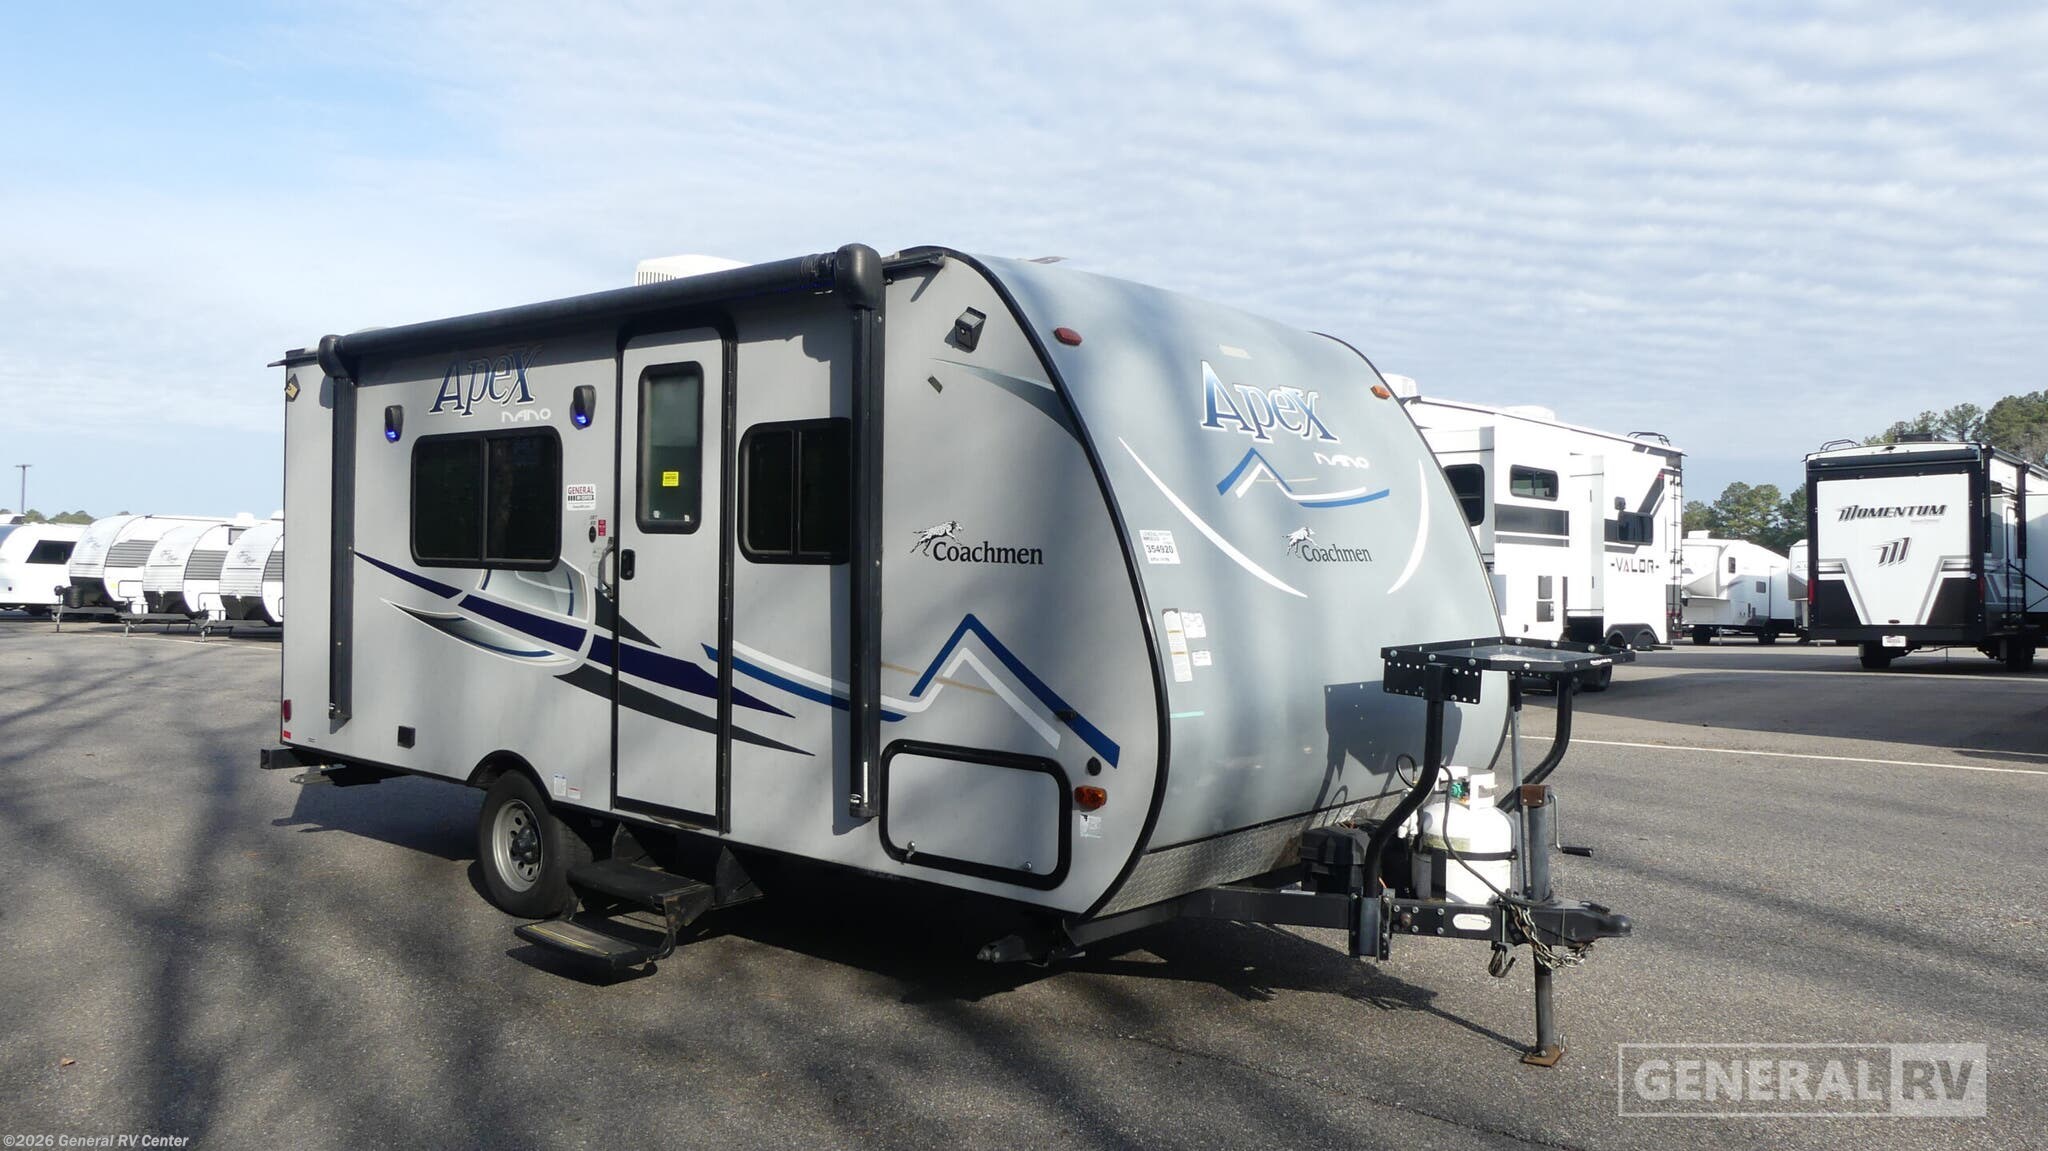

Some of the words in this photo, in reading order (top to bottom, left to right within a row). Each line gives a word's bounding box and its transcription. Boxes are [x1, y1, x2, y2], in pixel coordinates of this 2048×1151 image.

[567, 486, 595, 495] GENERAL
[932, 540, 1044, 565] Coachmen
[1145, 544, 1174, 554] 354920
[1301, 543, 1373, 563] Coachmen
